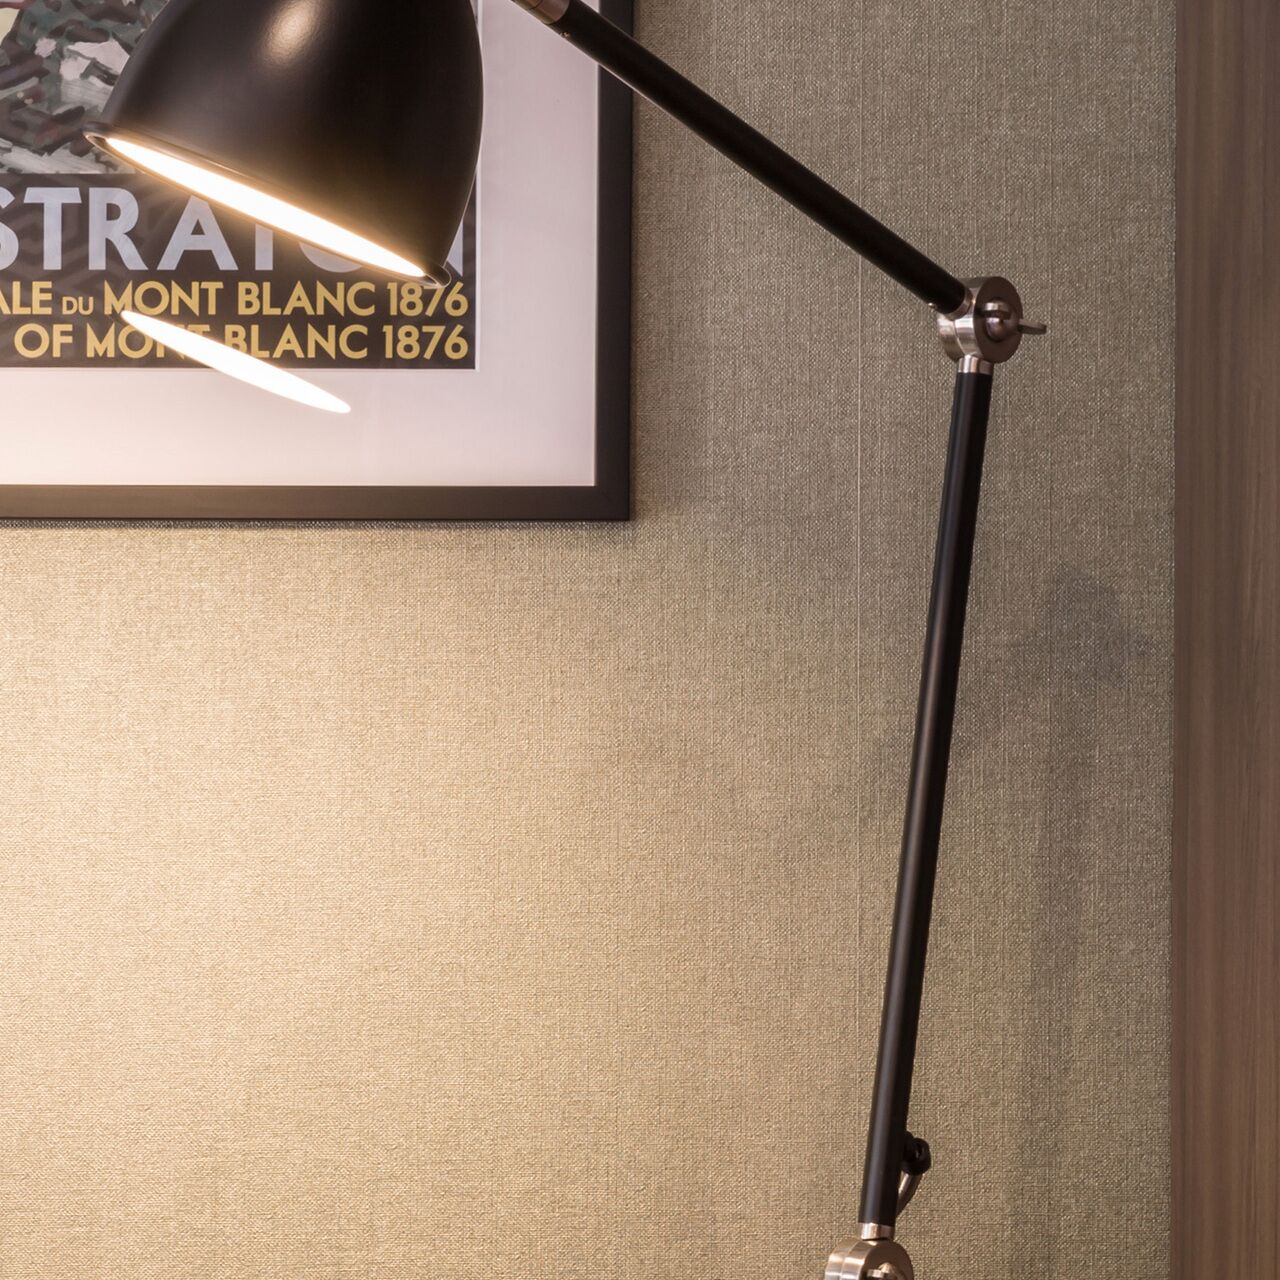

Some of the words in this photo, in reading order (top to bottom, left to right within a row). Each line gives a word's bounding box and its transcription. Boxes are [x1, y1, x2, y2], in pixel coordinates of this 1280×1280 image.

[61, 296, 94, 316] DU
[104, 279, 224, 317] MONT
[237, 280, 376, 318] BLANC
[387, 280, 469, 319] 1876
[13, 322, 73, 359] OF
[224, 322, 368, 361] BLANC
[382, 322, 469, 361] 1876
